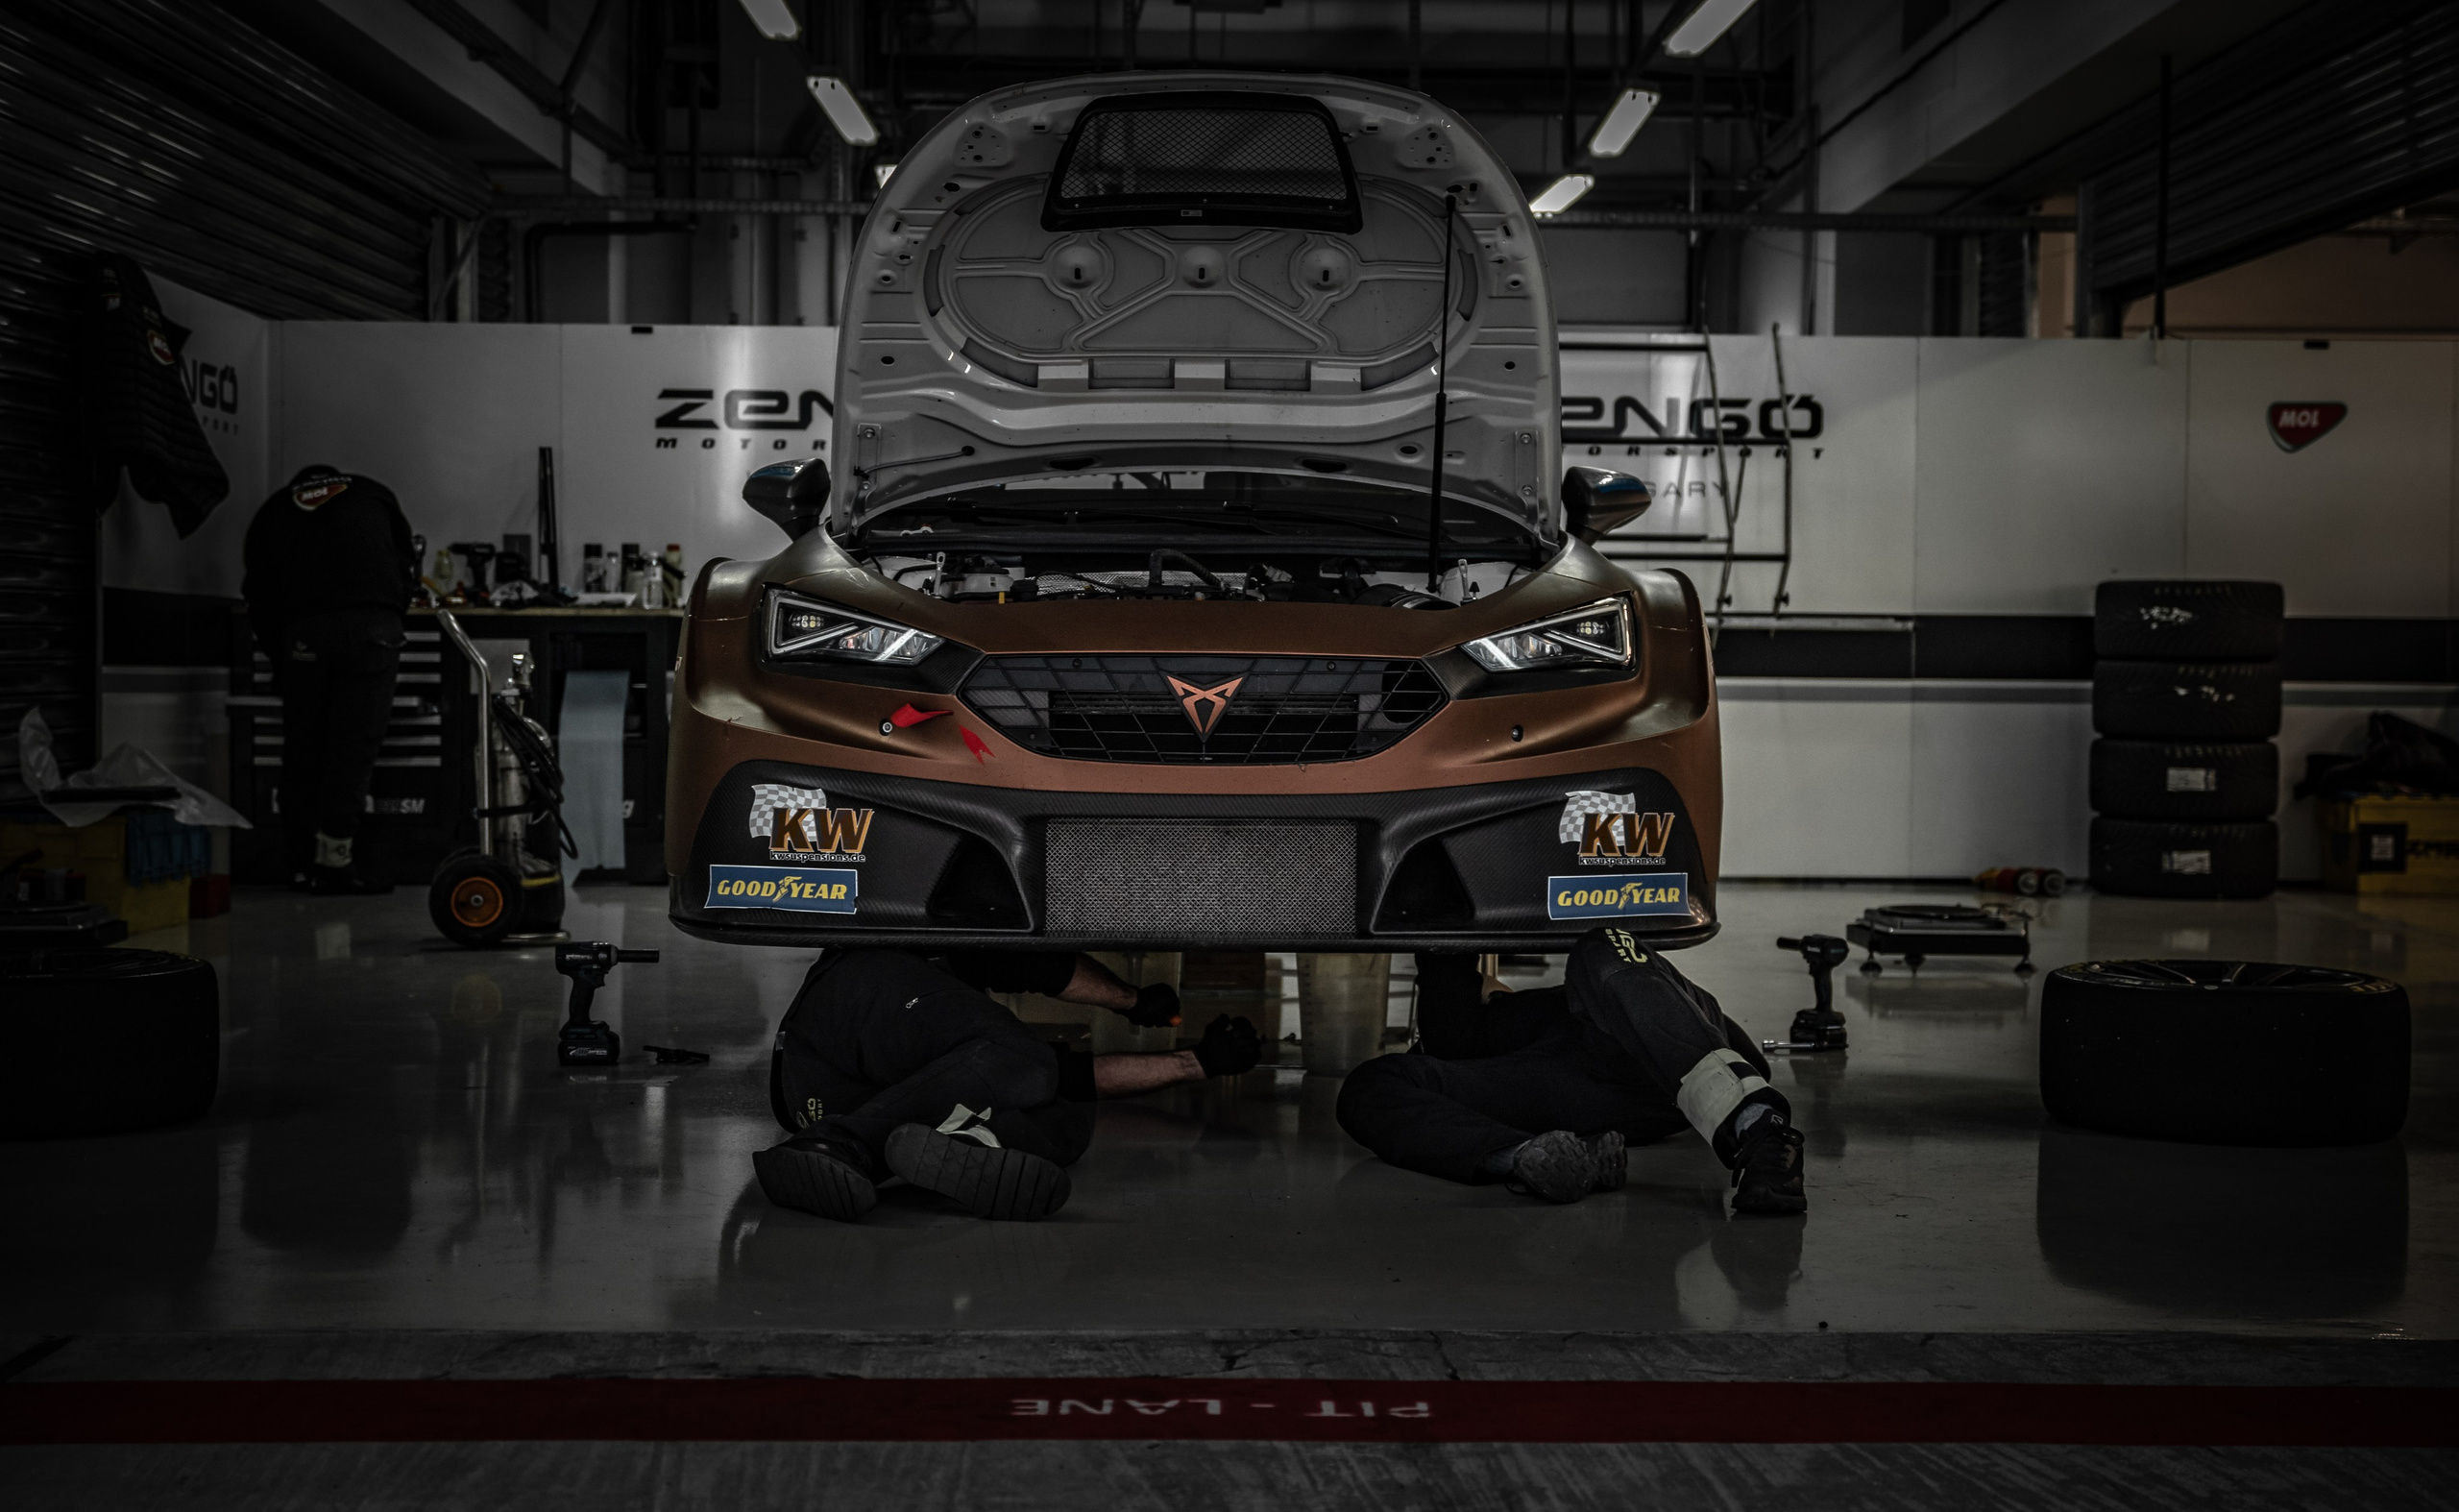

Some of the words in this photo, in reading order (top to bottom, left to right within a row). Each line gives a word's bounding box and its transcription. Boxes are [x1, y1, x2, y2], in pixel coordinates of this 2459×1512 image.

[2277, 408, 2321, 428] MOL
[656, 438, 826, 451] MOTOR
[769, 808, 875, 853] KW
[1578, 813, 1675, 857] KW
[769, 851, 865, 863] kwsuspensions.de
[1578, 856, 1667, 867] kwsuspensions.de
[1010, 1399, 1222, 1416] LANE
[1303, 1401, 1430, 1419] PIT
